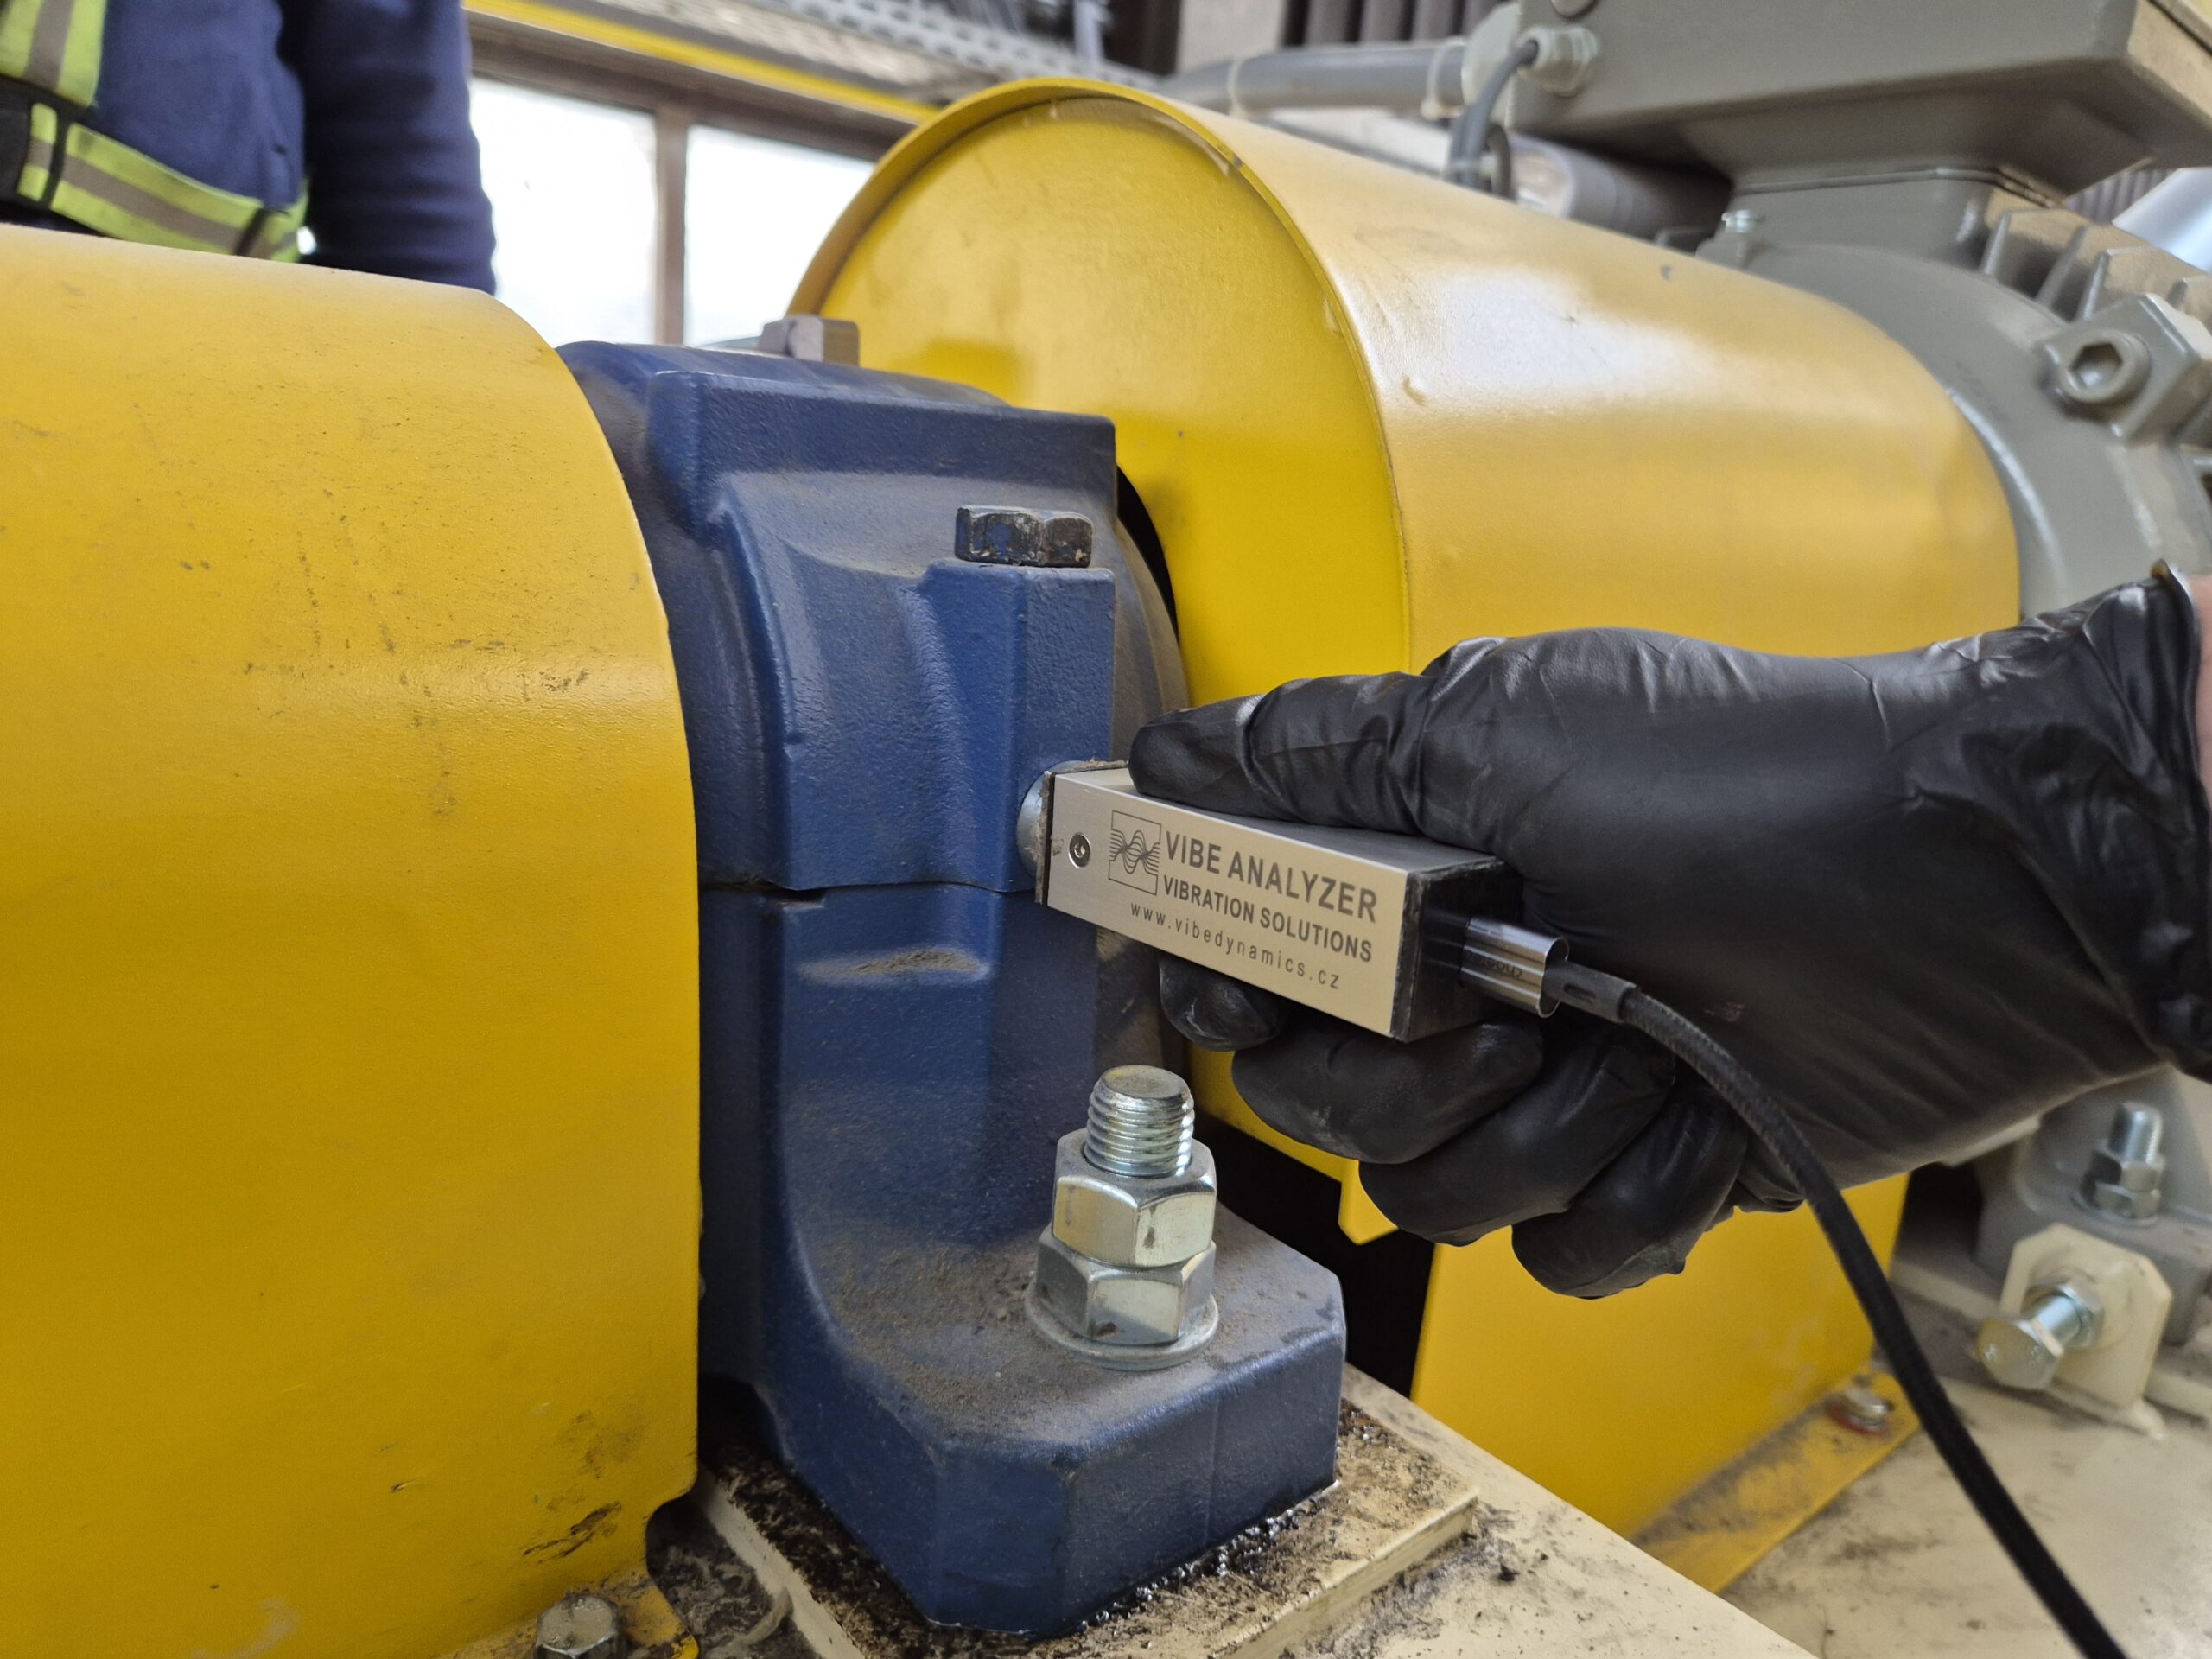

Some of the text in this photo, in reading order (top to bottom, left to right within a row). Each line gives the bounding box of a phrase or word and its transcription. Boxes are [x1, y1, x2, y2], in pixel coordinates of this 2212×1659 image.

[1163, 874, 1373, 963] VIBRATION SOLUTIONS
[1166, 830, 1378, 924] VIBE ANALYZER
[1130, 902, 1339, 989] www.vibedynamics.cz
